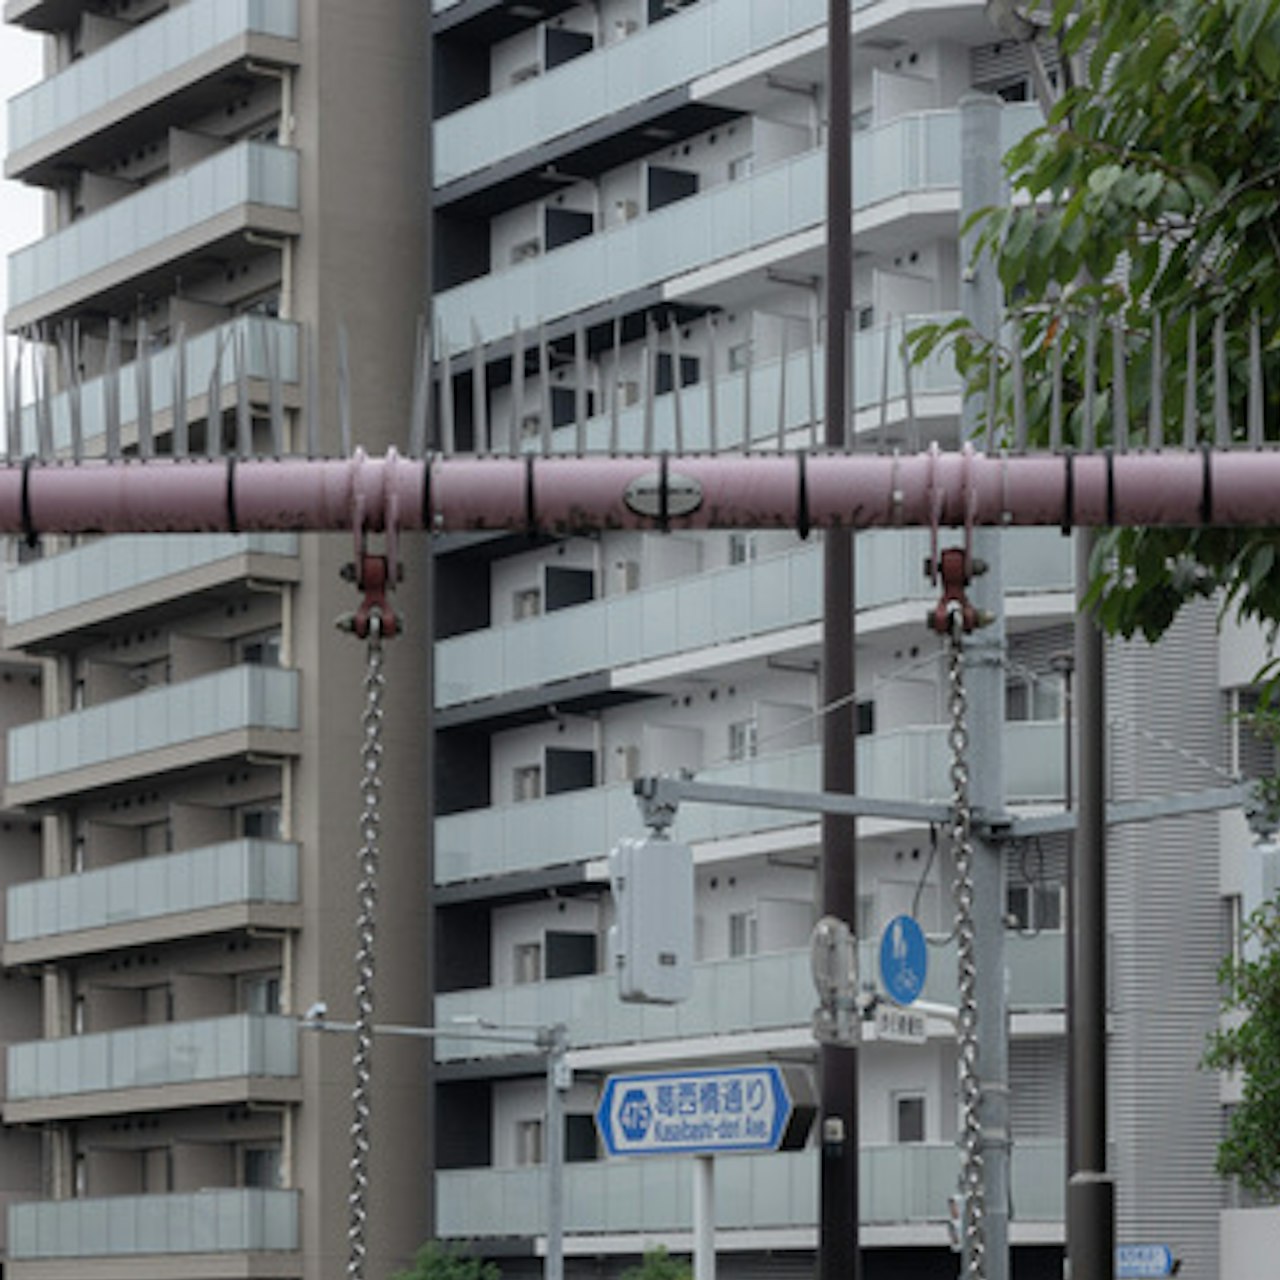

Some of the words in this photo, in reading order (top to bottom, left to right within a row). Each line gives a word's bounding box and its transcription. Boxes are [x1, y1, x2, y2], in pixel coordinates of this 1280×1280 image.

[655, 1079, 766, 1116] 葛西橋通り
[621, 1101, 651, 1129] 475
